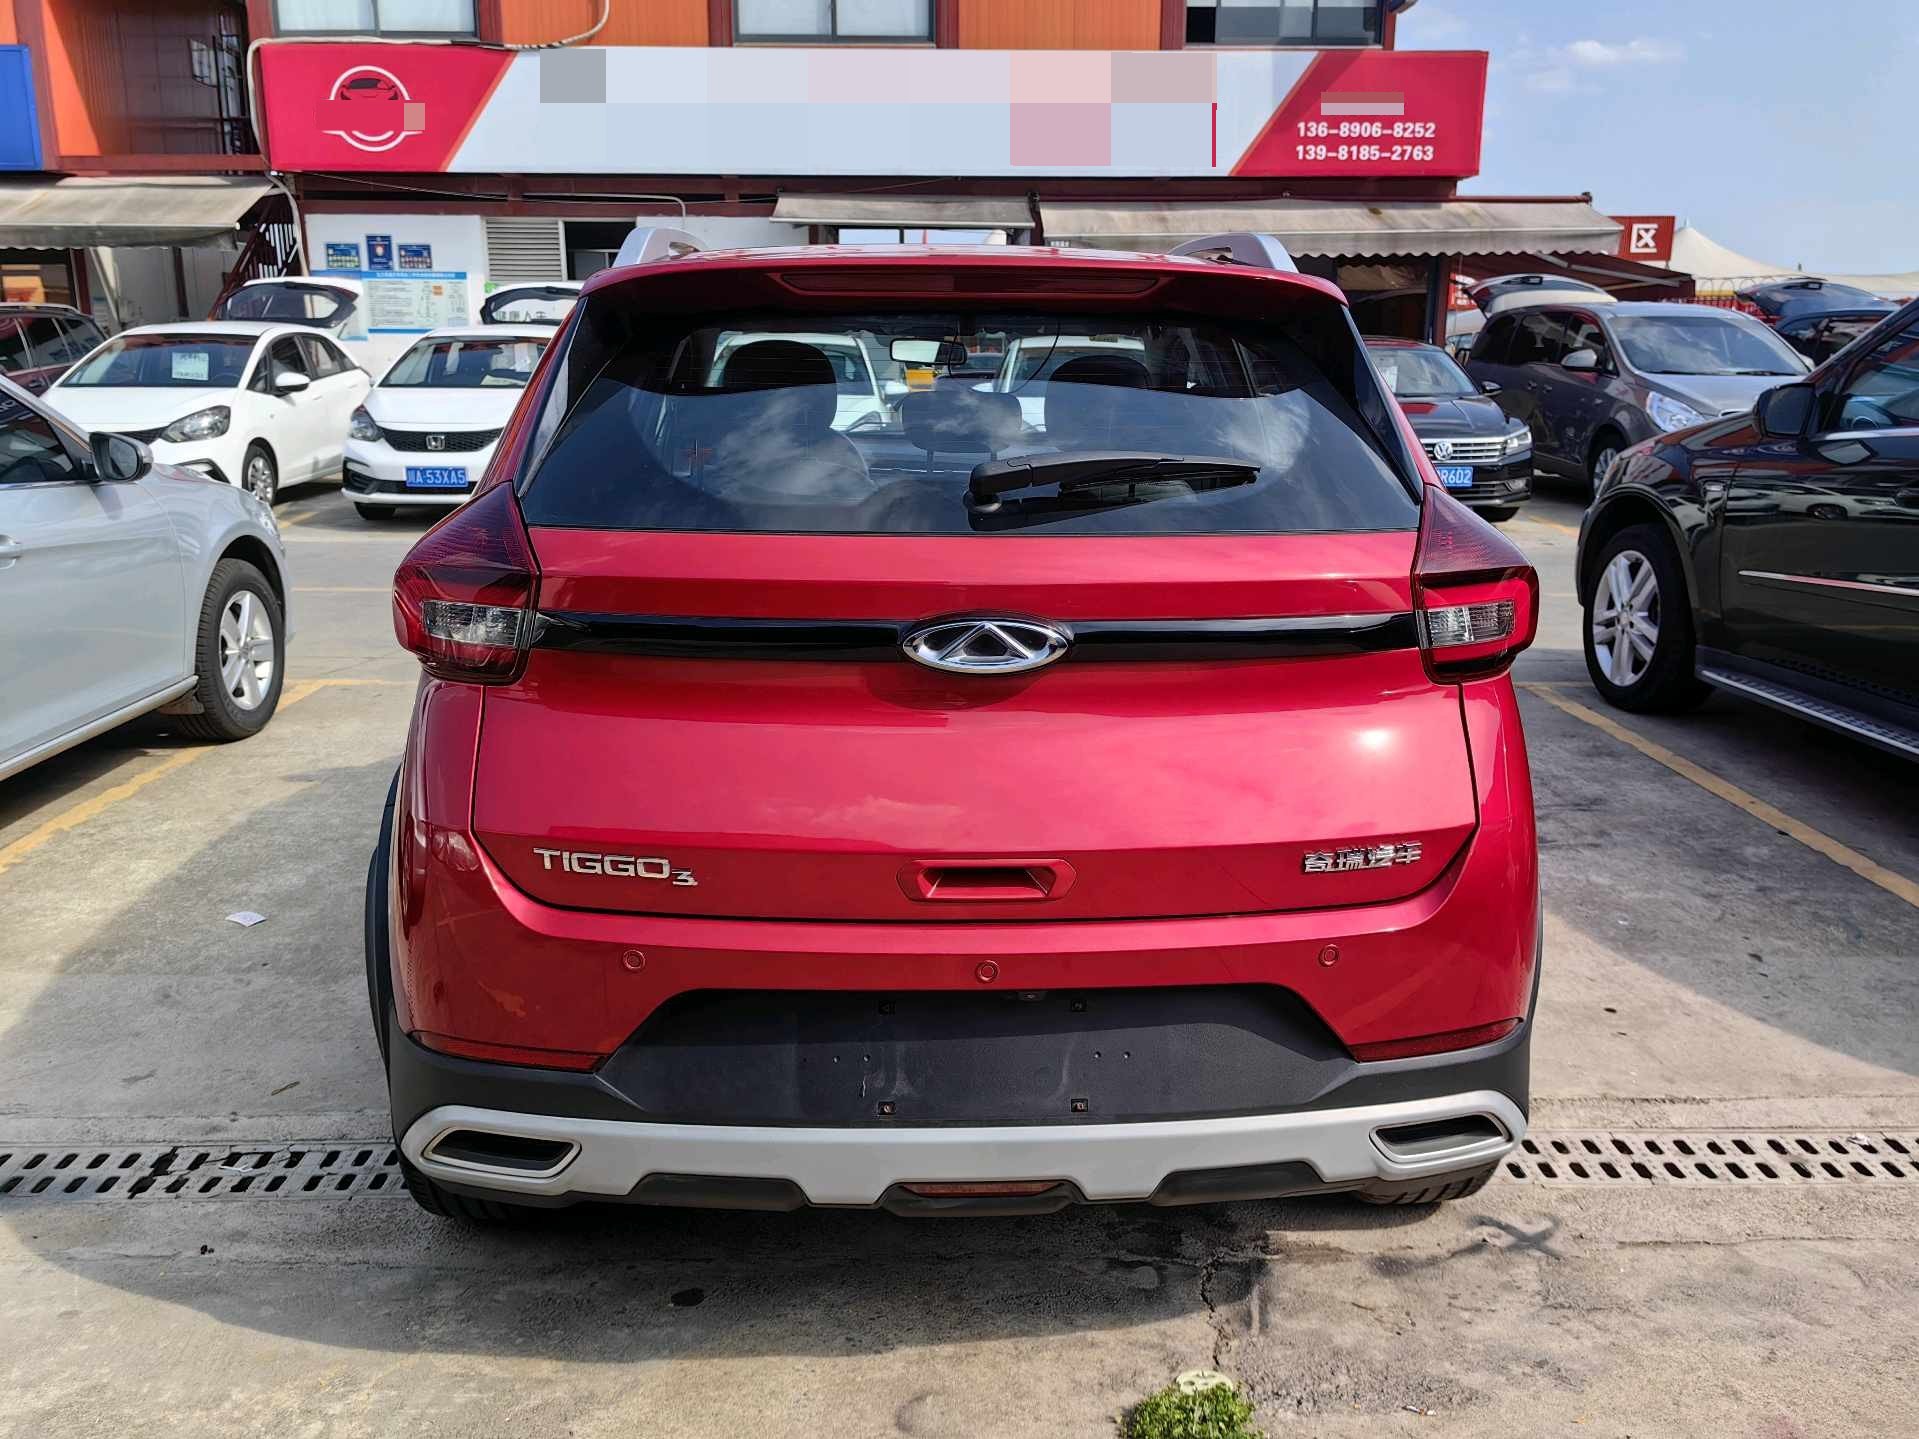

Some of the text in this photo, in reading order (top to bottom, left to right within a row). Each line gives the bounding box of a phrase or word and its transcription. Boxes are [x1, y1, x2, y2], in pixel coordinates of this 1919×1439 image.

[1297, 122, 1436, 138] 136-8906-8252
[1296, 145, 1434, 161] 139-8185-2763
[1630, 223, 1659, 254] 区
[1437, 469, 1472, 484] R6D2
[1304, 840, 1423, 873] 奇瑞汽车
